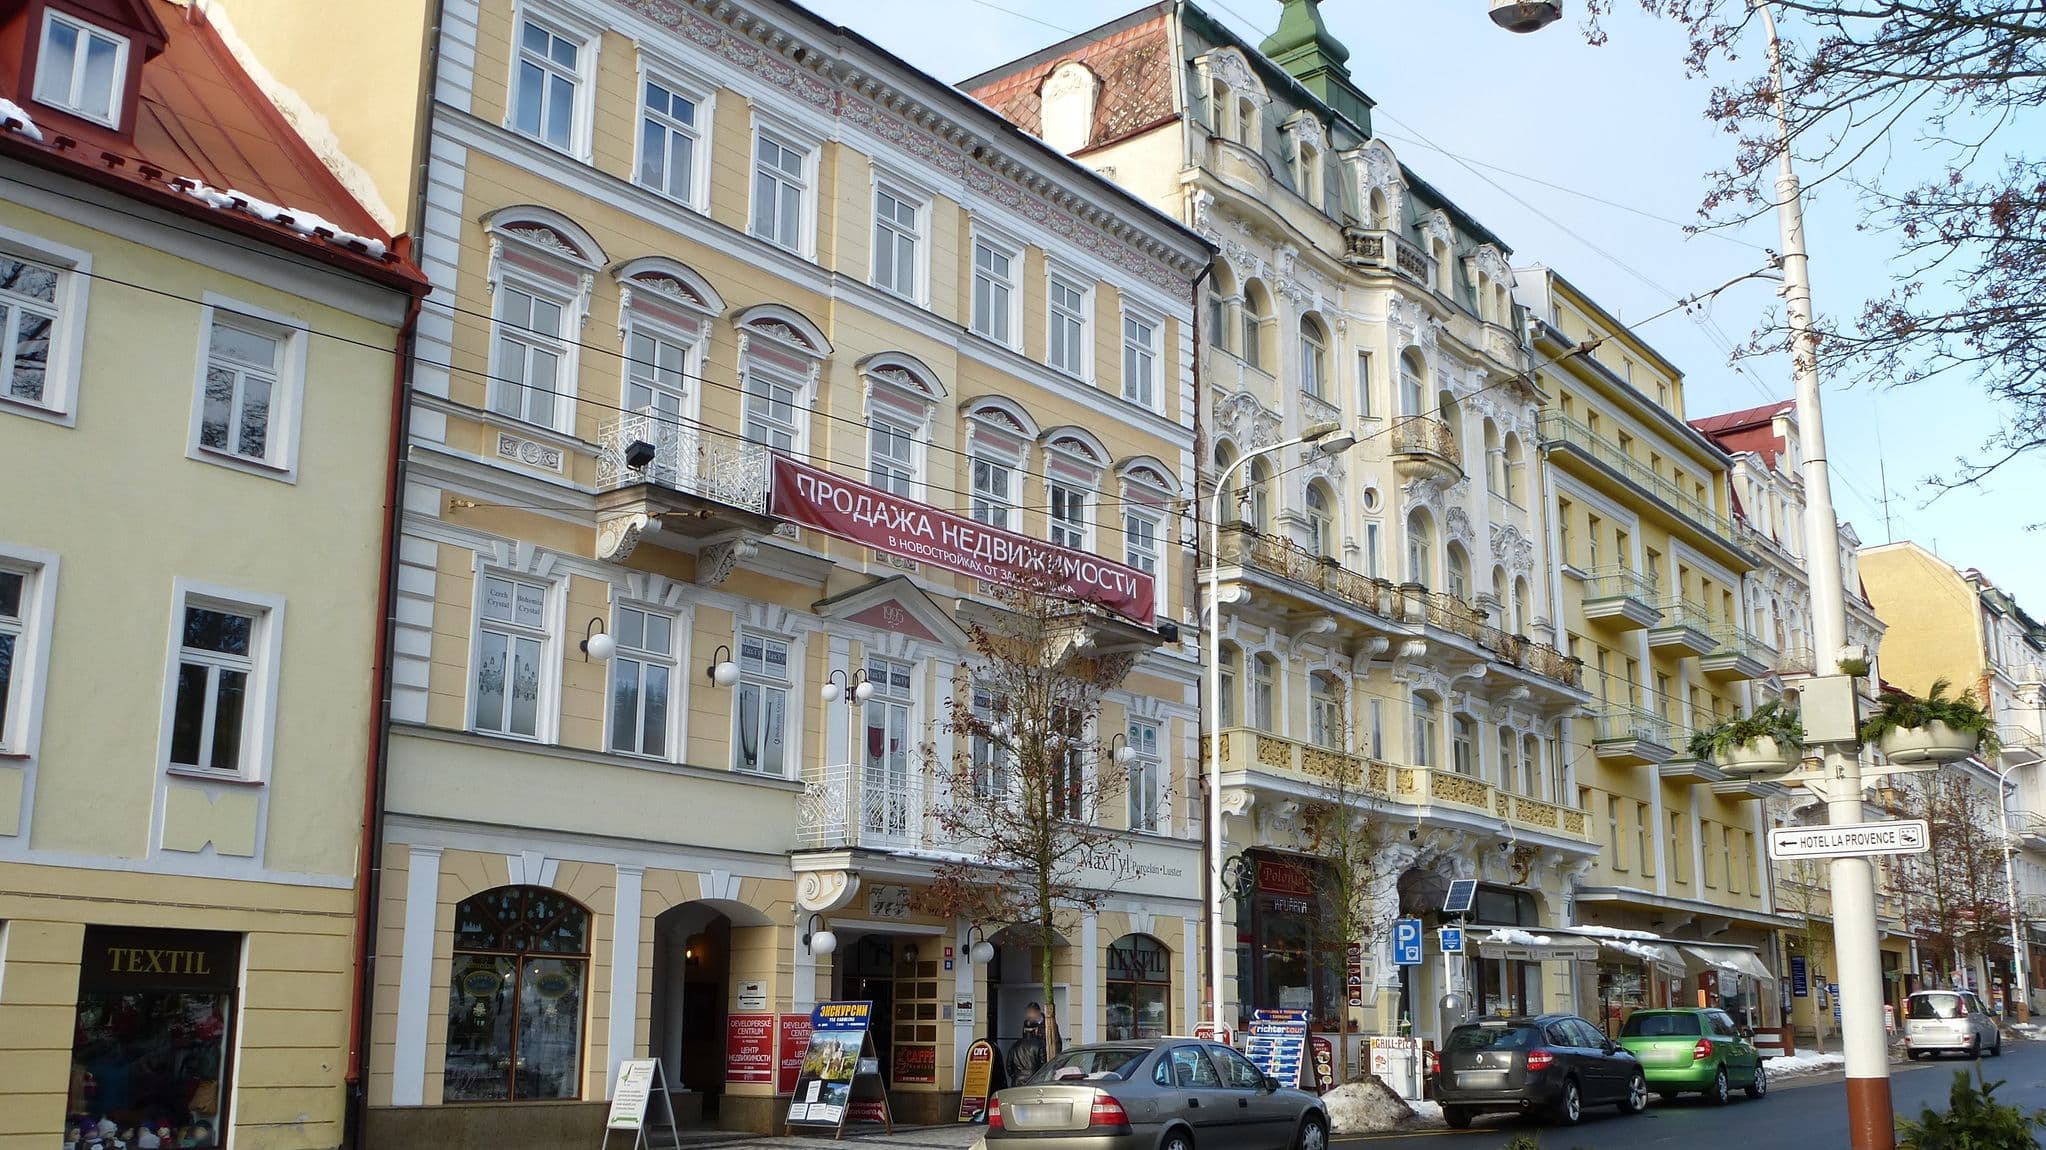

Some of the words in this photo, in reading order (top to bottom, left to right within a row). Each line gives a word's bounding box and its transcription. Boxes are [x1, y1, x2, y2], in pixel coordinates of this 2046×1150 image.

[796, 472, 935, 540] ПРОДАЖА
[889, 535, 897, 547] В
[899, 538, 983, 574] НОВОСТРОЙКАХ
[984, 563, 998, 578] ОТ
[518, 604, 541, 615] Crystal
[883, 606, 904, 624] 1995
[1800, 836, 1830, 849] HOTEL
[1832, 835, 1843, 847] LA
[1845, 831, 1896, 846] PROVENCE
[1080, 848, 1130, 878] MaxTyl
[1399, 924, 1416, 950] P
[107, 947, 211, 975] TEXTIL
[820, 1004, 868, 1017] ЭКСКУРСИИ
[730, 1017, 772, 1028] DEVELOPERSKÉ
[783, 1021, 812, 1030] DEVELOPE
[737, 1027, 764, 1036] CENTRUM
[790, 1029, 811, 1037] CENTR
[1375, 1038, 1419, 1049] GRILL-PIZA
[740, 1046, 759, 1055] ЦЕНТР
